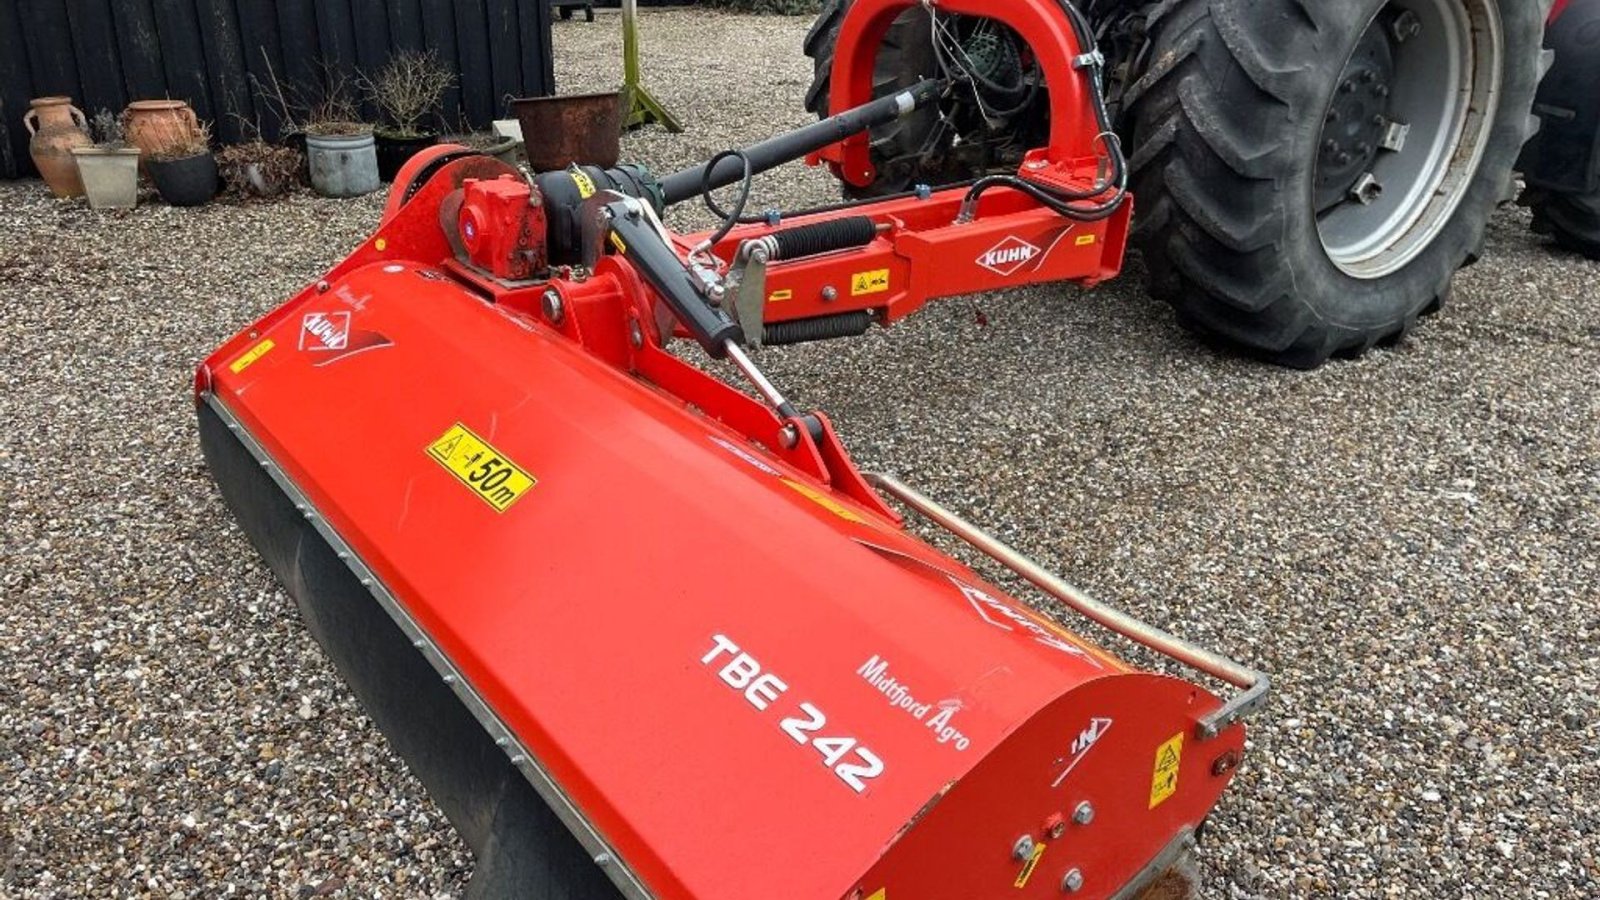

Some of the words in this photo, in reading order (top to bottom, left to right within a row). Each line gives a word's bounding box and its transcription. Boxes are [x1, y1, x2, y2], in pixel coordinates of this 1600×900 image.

[984, 246, 1031, 266] KUHN
[468, 458, 515, 505] 50m
[701, 634, 788, 712] TBE
[779, 702, 885, 794] 242
[856, 655, 932, 720] Midtfjord
[925, 705, 970, 751] Agro
